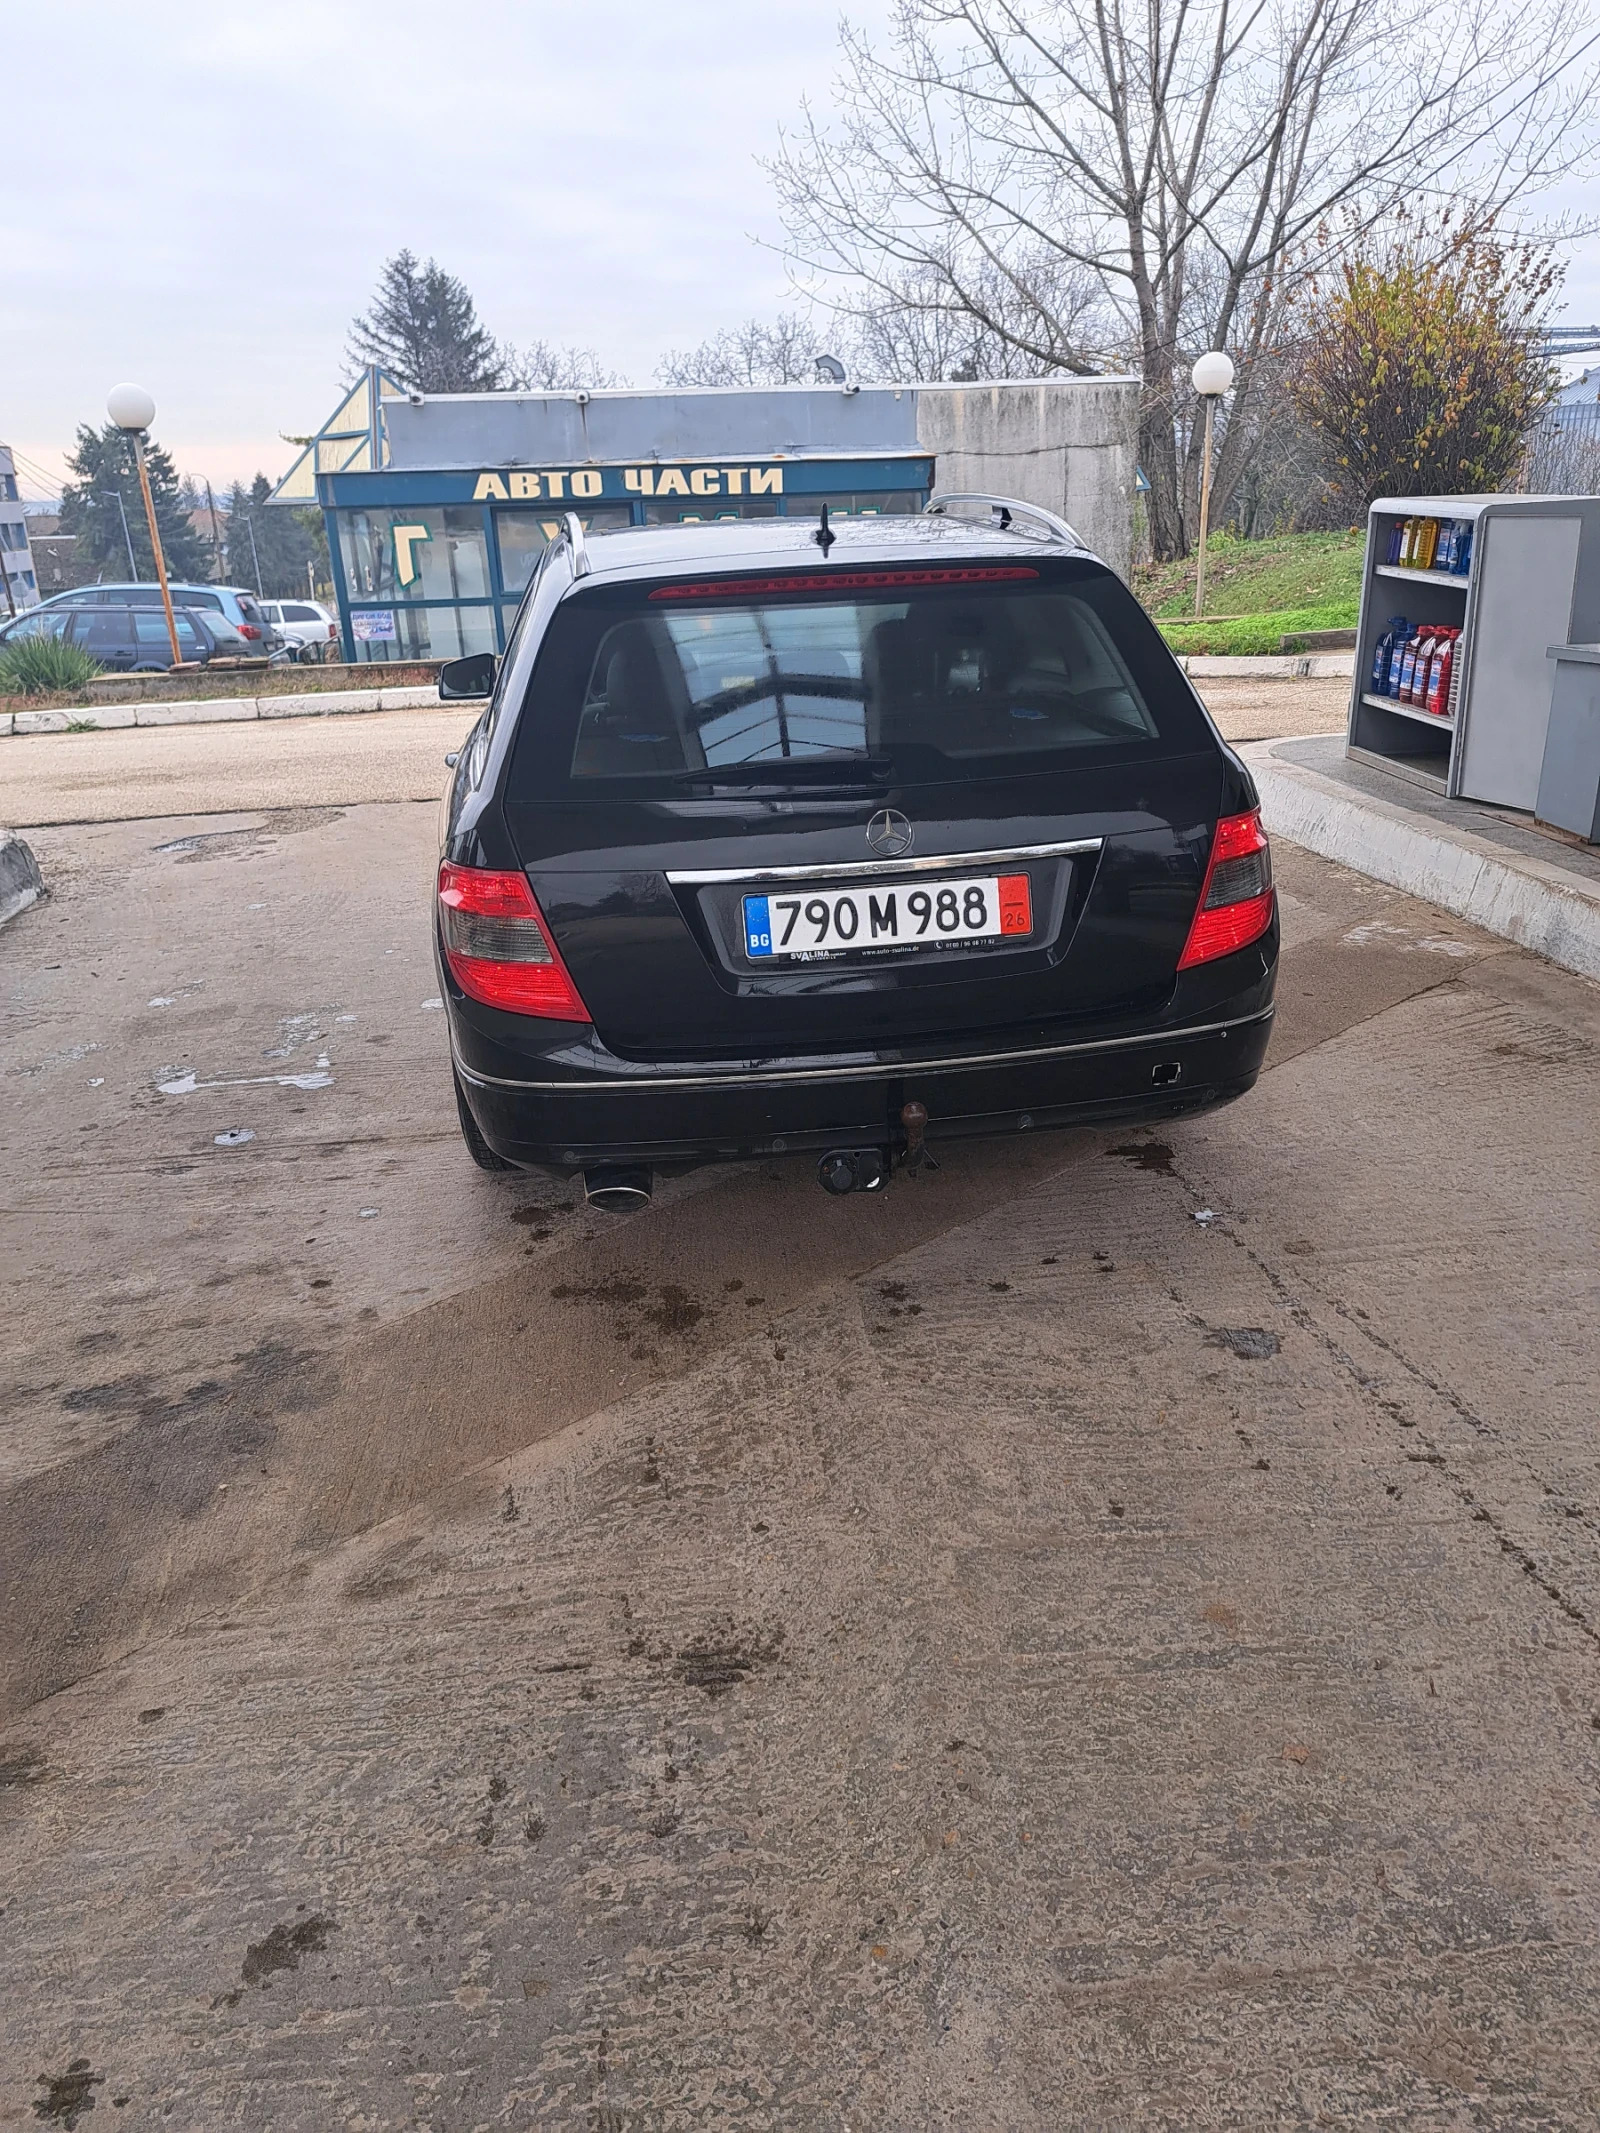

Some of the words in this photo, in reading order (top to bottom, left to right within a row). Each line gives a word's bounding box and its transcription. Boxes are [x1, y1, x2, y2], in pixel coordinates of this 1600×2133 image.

[472, 470, 603, 499] АВТО
[624, 468, 784, 495] ЧАСТИ
[776, 897, 859, 946] 790
[868, 893, 898, 938] M
[907, 886, 987, 935] 988
[1005, 912, 1025, 927] 26
[750, 934, 770, 948] BG
[790, 950, 830, 962] SVALINA
[861, 945, 920, 956] www.auto-svalina.de
